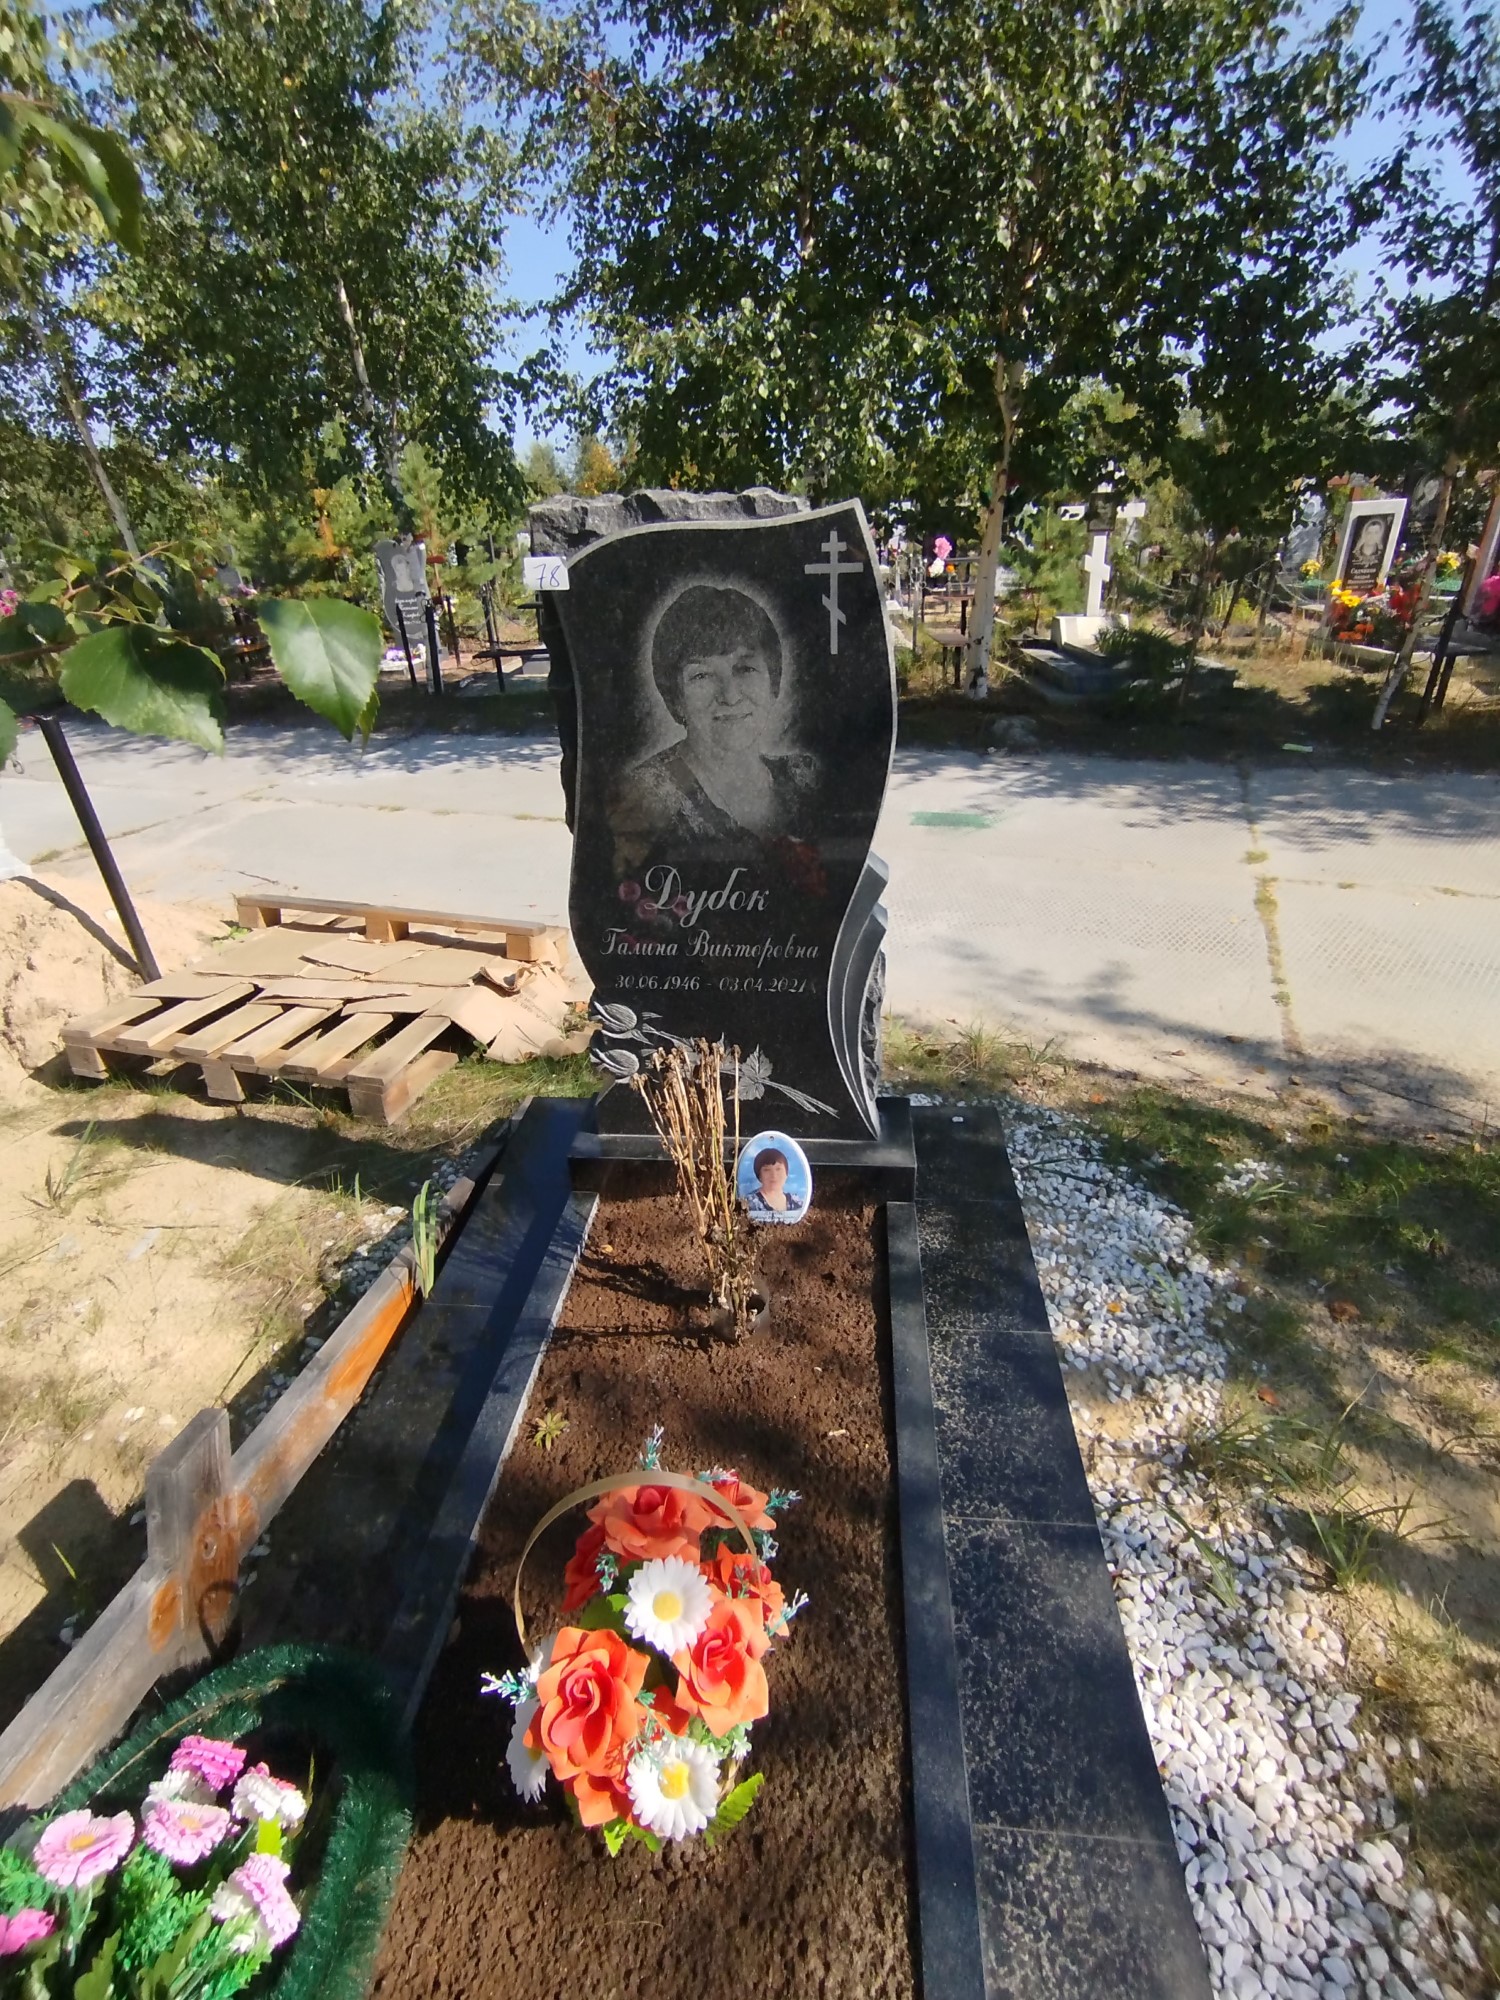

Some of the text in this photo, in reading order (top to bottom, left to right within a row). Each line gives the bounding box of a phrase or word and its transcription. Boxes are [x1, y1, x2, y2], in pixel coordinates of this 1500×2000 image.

[533, 563, 562, 589] 78
[643, 864, 770, 928] Дубок
[600, 927, 819, 968] Галина Викторовна
[615, 975, 700, 991] 30.06.1946
[719, 977, 807, 993] 03.04.2021
